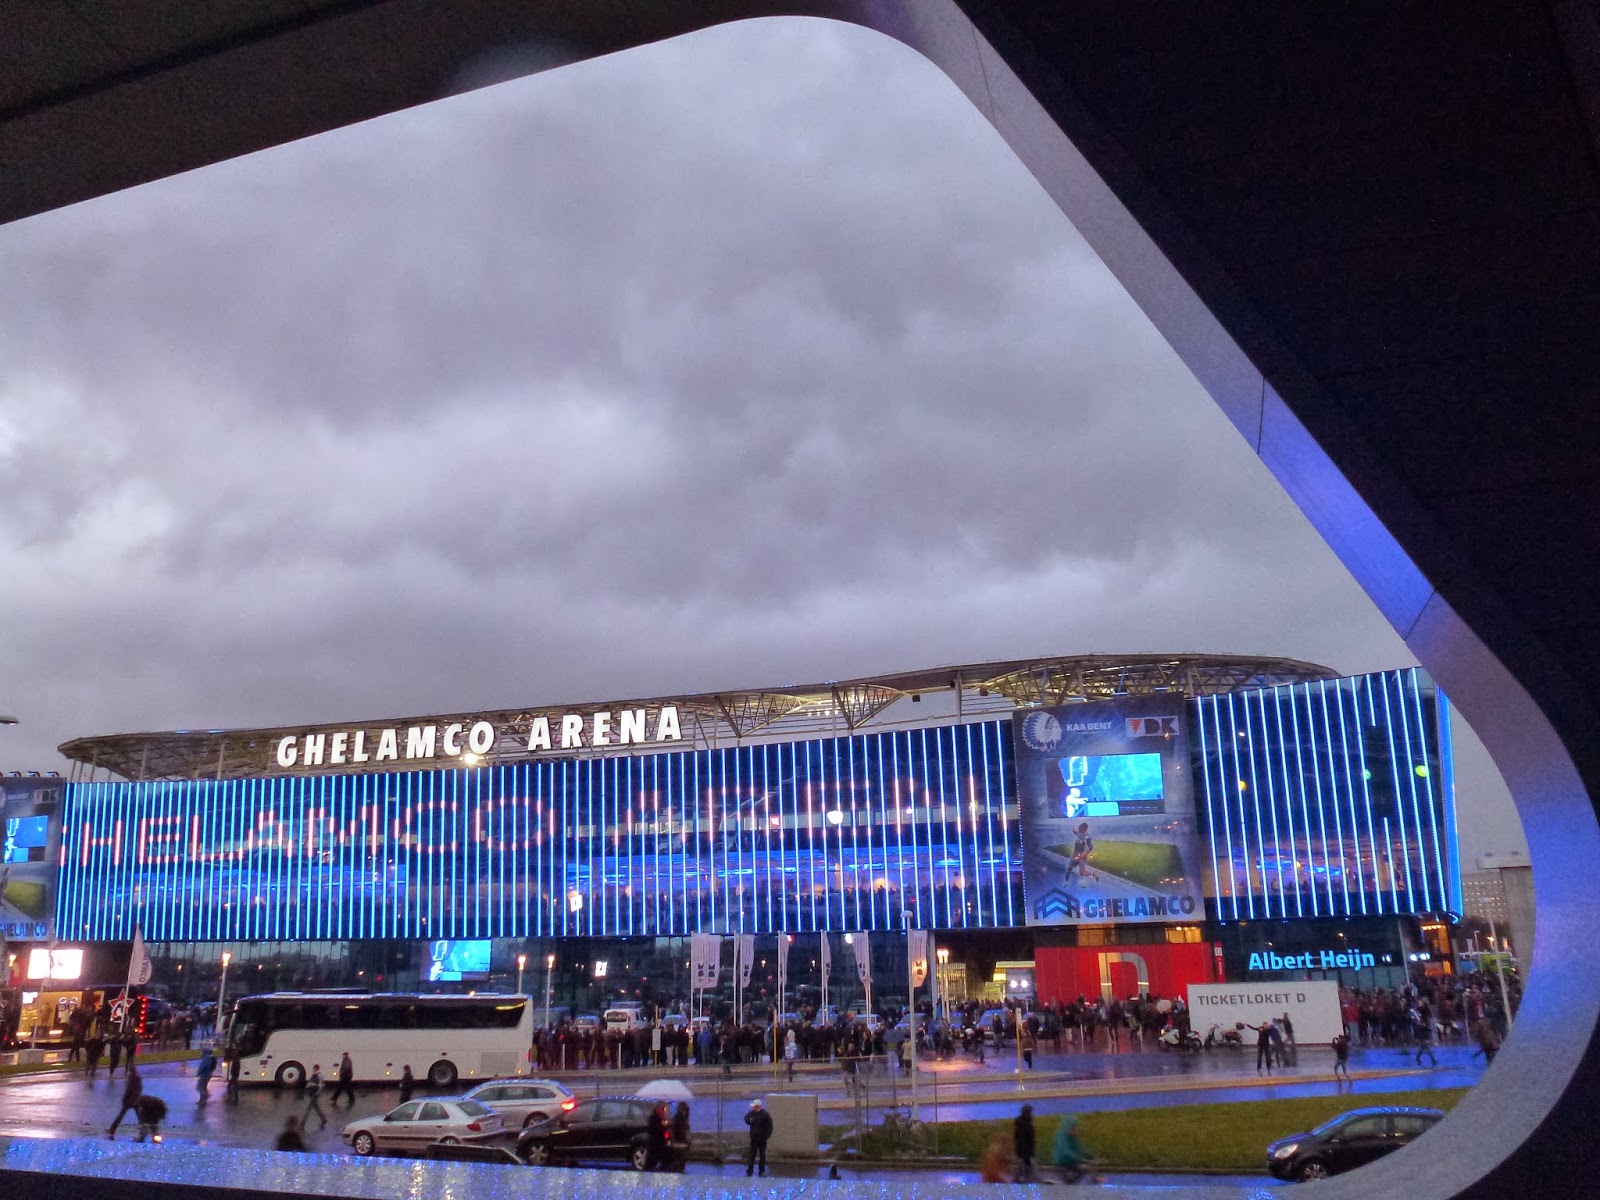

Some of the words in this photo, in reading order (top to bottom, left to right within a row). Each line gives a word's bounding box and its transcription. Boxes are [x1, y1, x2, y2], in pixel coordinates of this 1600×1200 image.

[277, 721, 495, 767] GHELAMCO
[527, 706, 682, 750] ARENA
[1066, 723, 1086, 732] KAA
[1087, 722, 1112, 730] GENT
[1083, 895, 1196, 918] GHELAMCO
[1248, 951, 1314, 970] Albert
[1320, 949, 1375, 971] Heijn
[1197, 993, 1291, 1005] TICKETLOKET
[1296, 993, 1306, 1003] D
